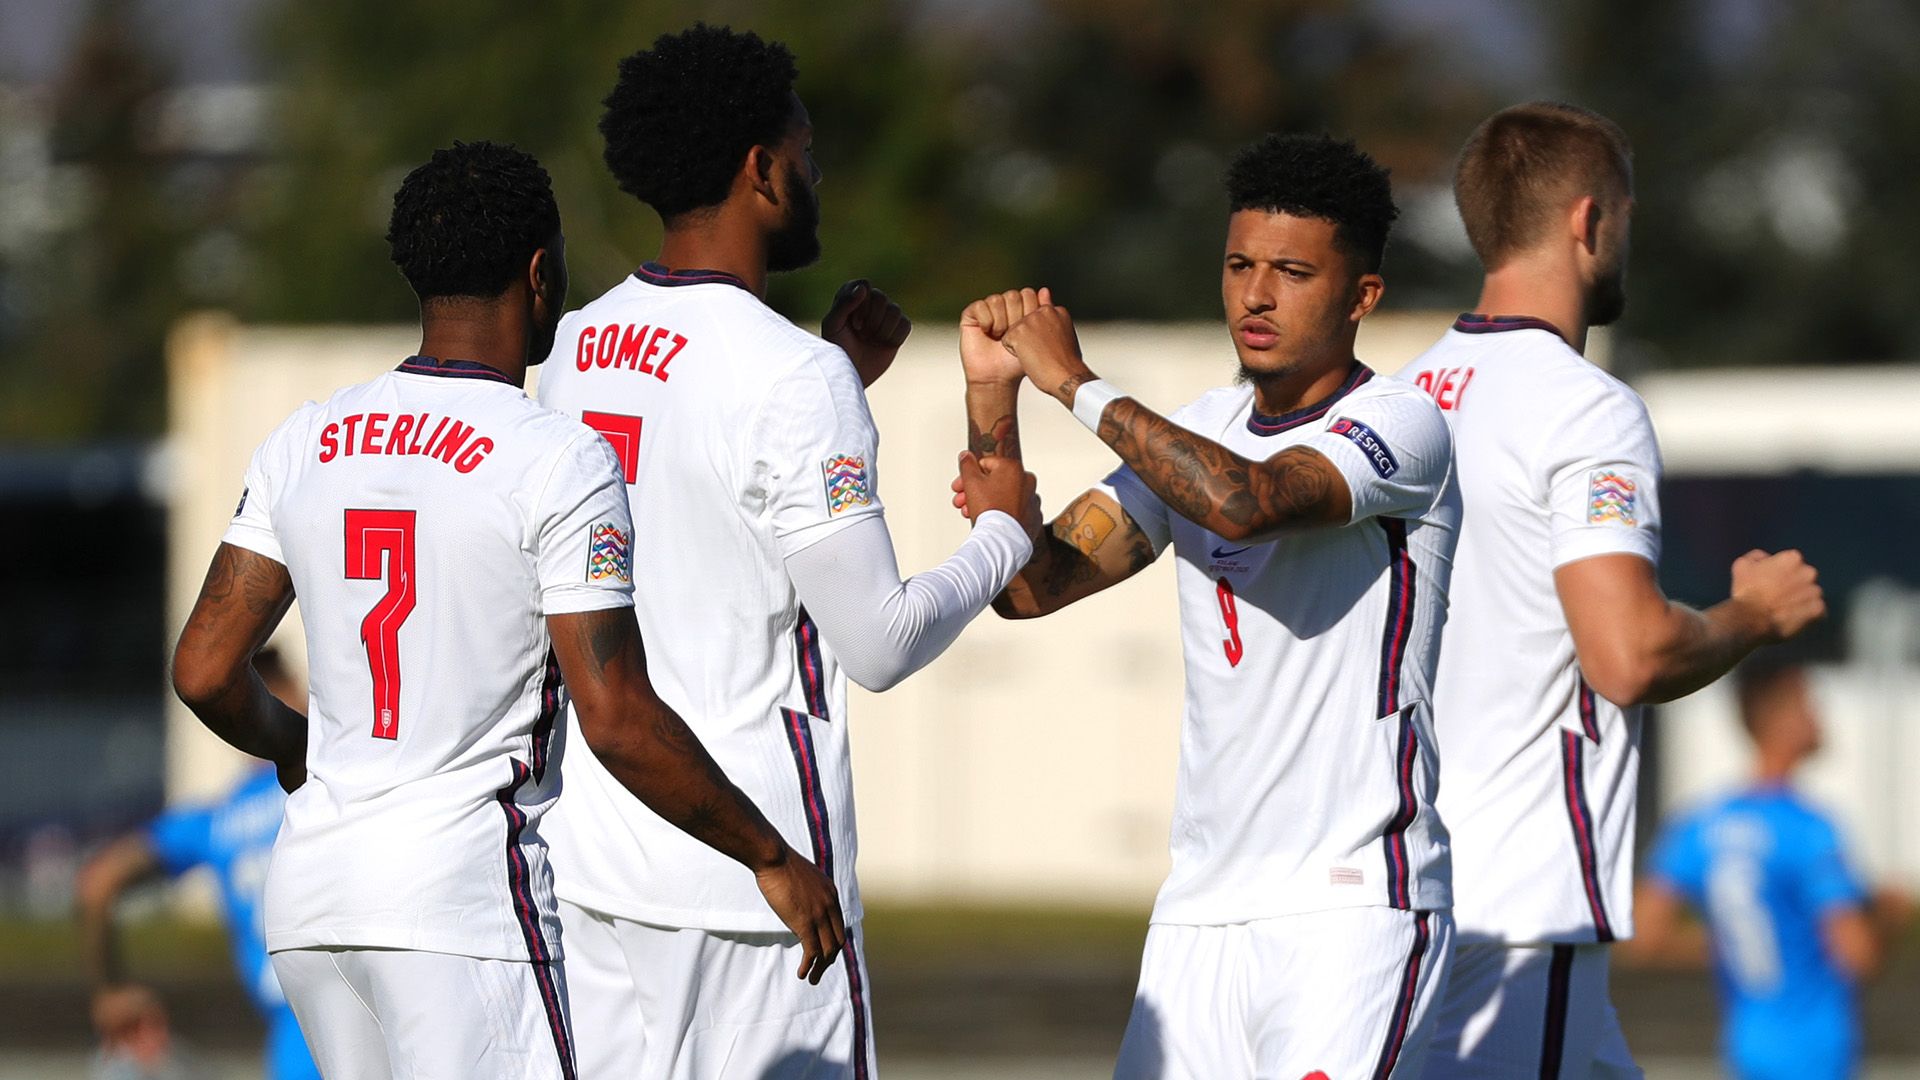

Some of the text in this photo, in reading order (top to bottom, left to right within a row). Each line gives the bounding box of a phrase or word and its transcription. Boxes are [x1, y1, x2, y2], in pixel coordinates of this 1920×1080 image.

[576, 323, 688, 383] GOMEZ
[319, 413, 494, 474] STERLING
[1347, 425, 1394, 475] RESPECT
[344, 508, 417, 741] 7
[1216, 576, 1243, 668] 9
